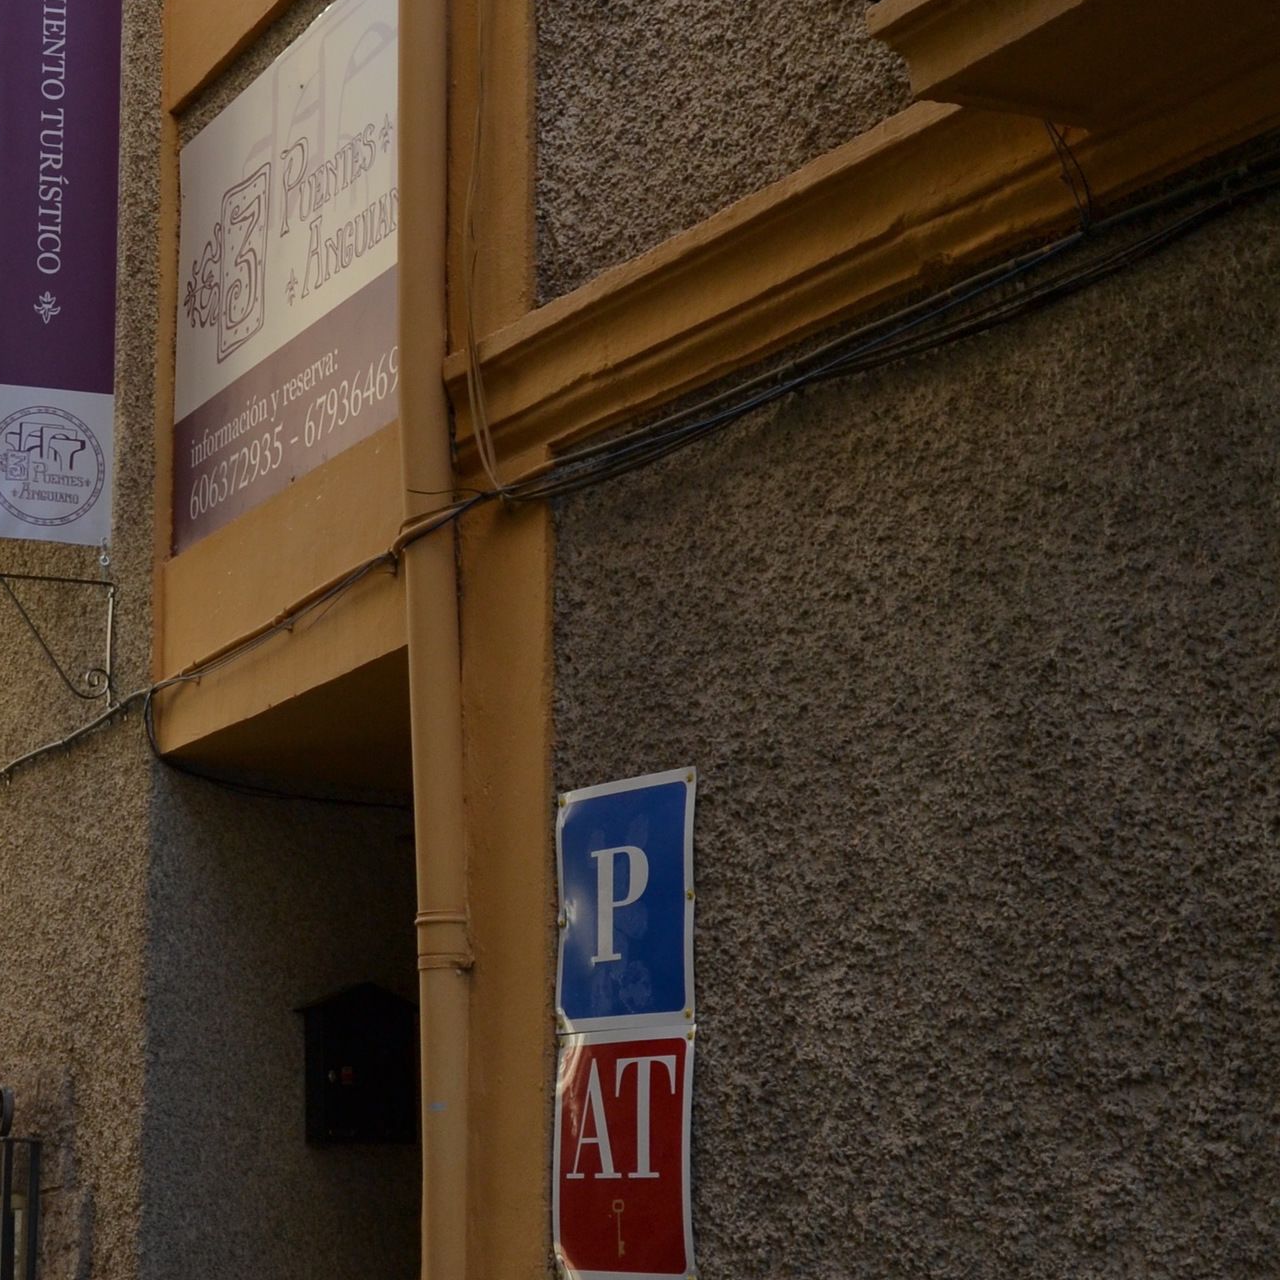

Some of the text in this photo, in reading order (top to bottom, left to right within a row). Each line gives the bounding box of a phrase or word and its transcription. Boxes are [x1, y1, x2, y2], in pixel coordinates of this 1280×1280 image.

[36, 109, 70, 275] TURÍSTICO
[225, 123, 376, 329] 3 PUENTES
[190, 347, 340, 468] información y reserva:
[32, 462, 84, 487] PUENTES
[189, 422, 284, 520] 606372935
[590, 844, 650, 965] P
[566, 1054, 678, 1180] AT
